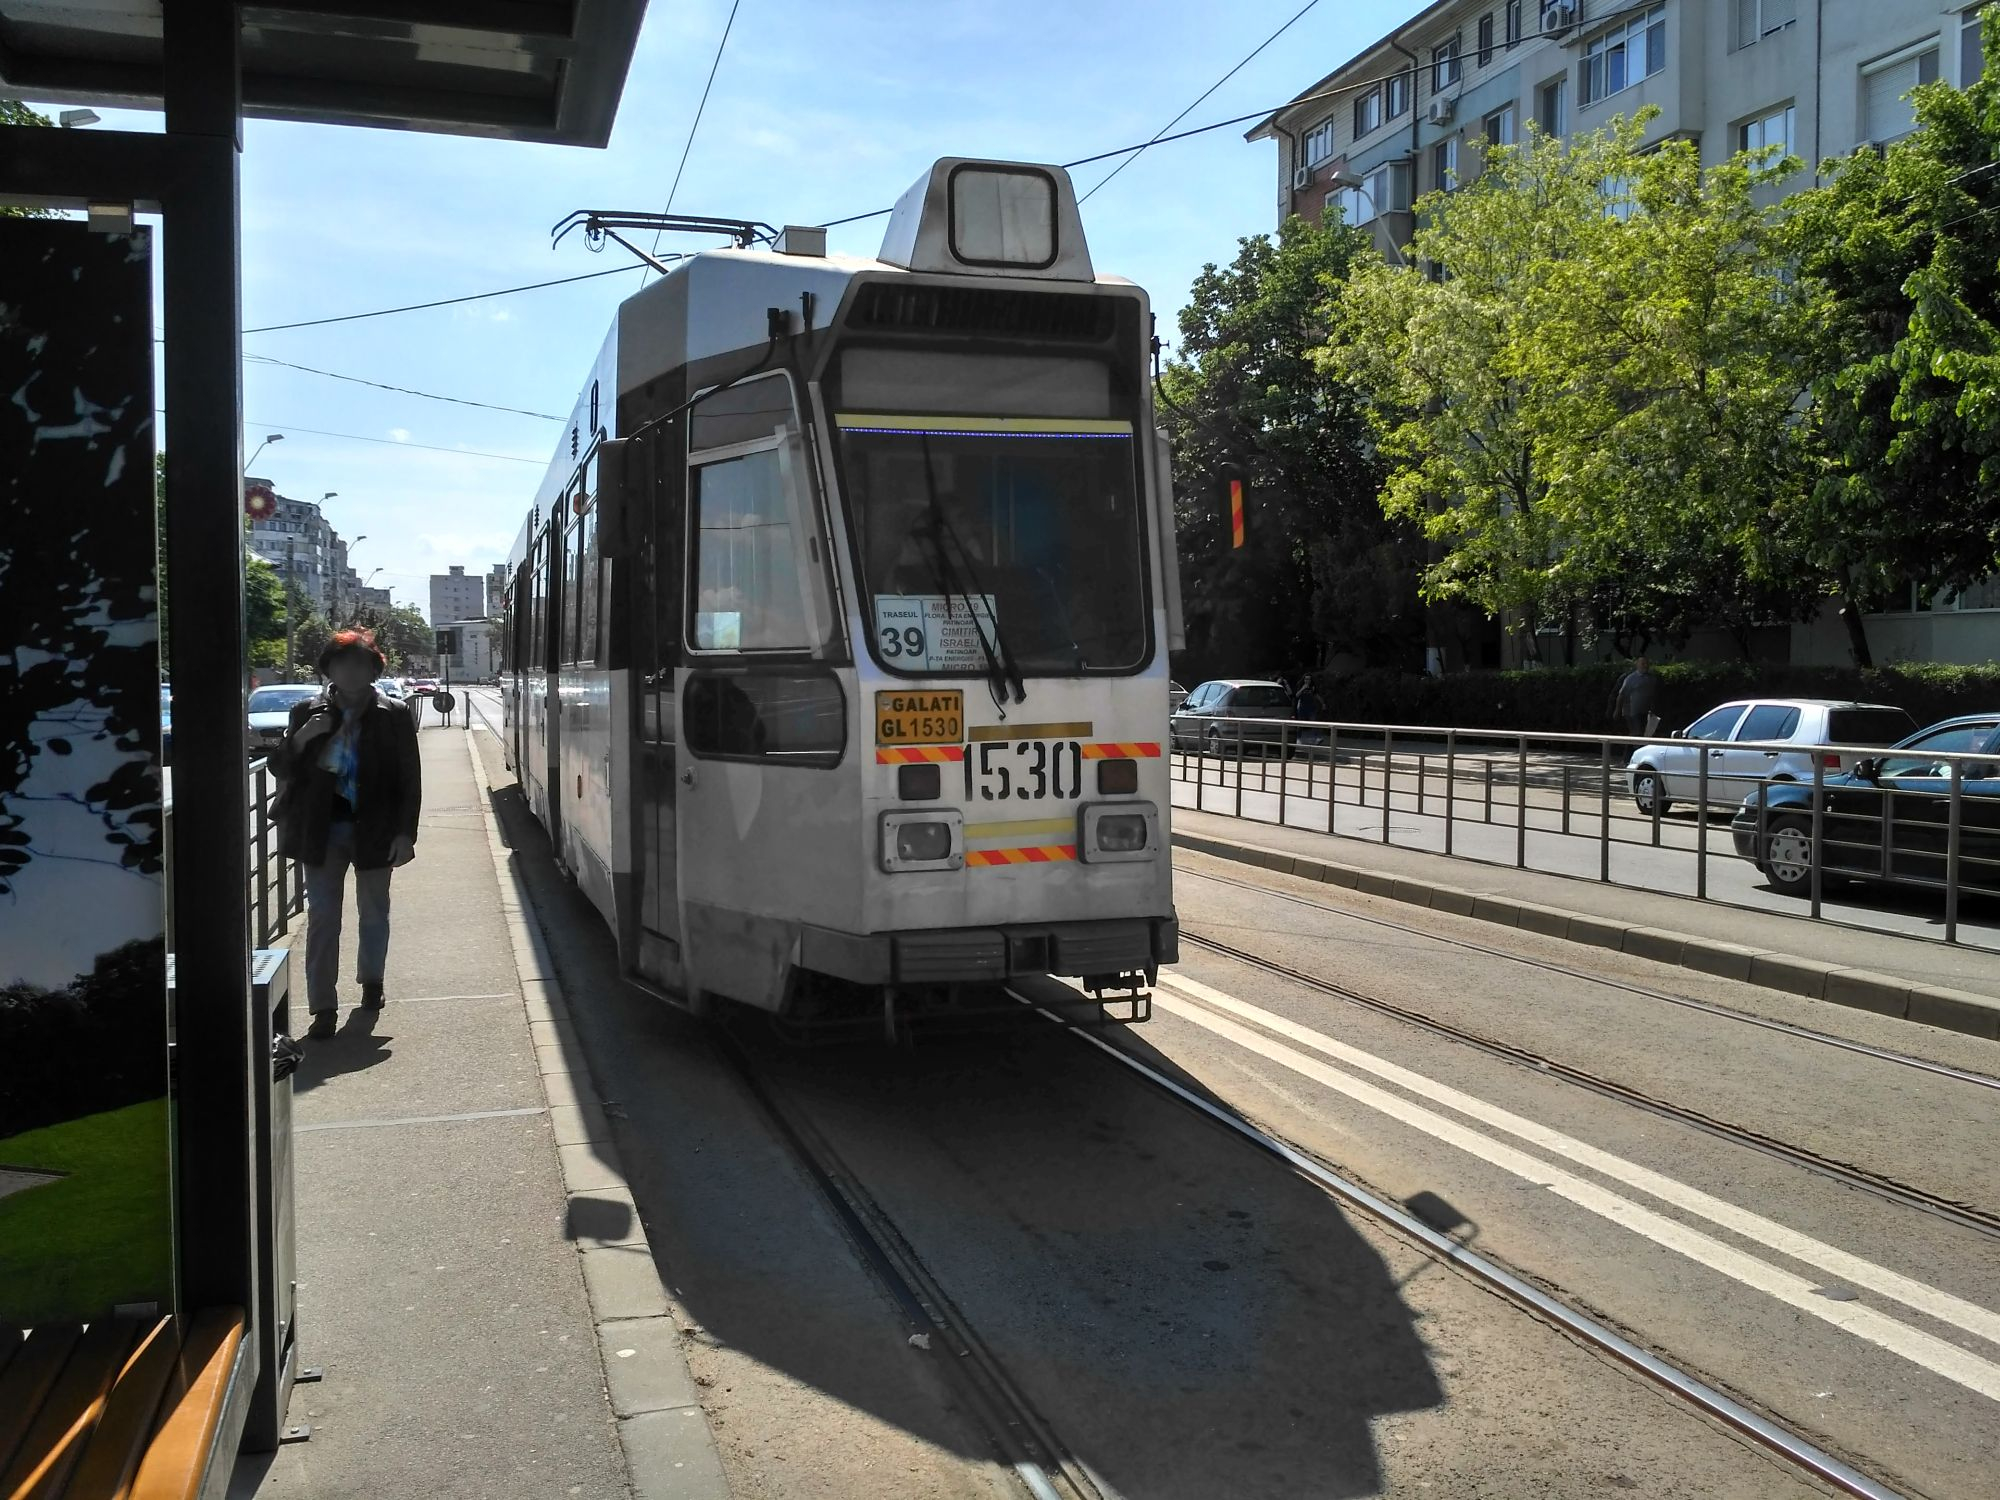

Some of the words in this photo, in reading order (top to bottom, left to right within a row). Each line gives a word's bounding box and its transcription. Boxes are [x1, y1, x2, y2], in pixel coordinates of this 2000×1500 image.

[882, 611, 919, 619] TRASEUL
[881, 626, 925, 658] 39
[892, 696, 960, 712] GALATI
[963, 741, 1082, 802] 1530
